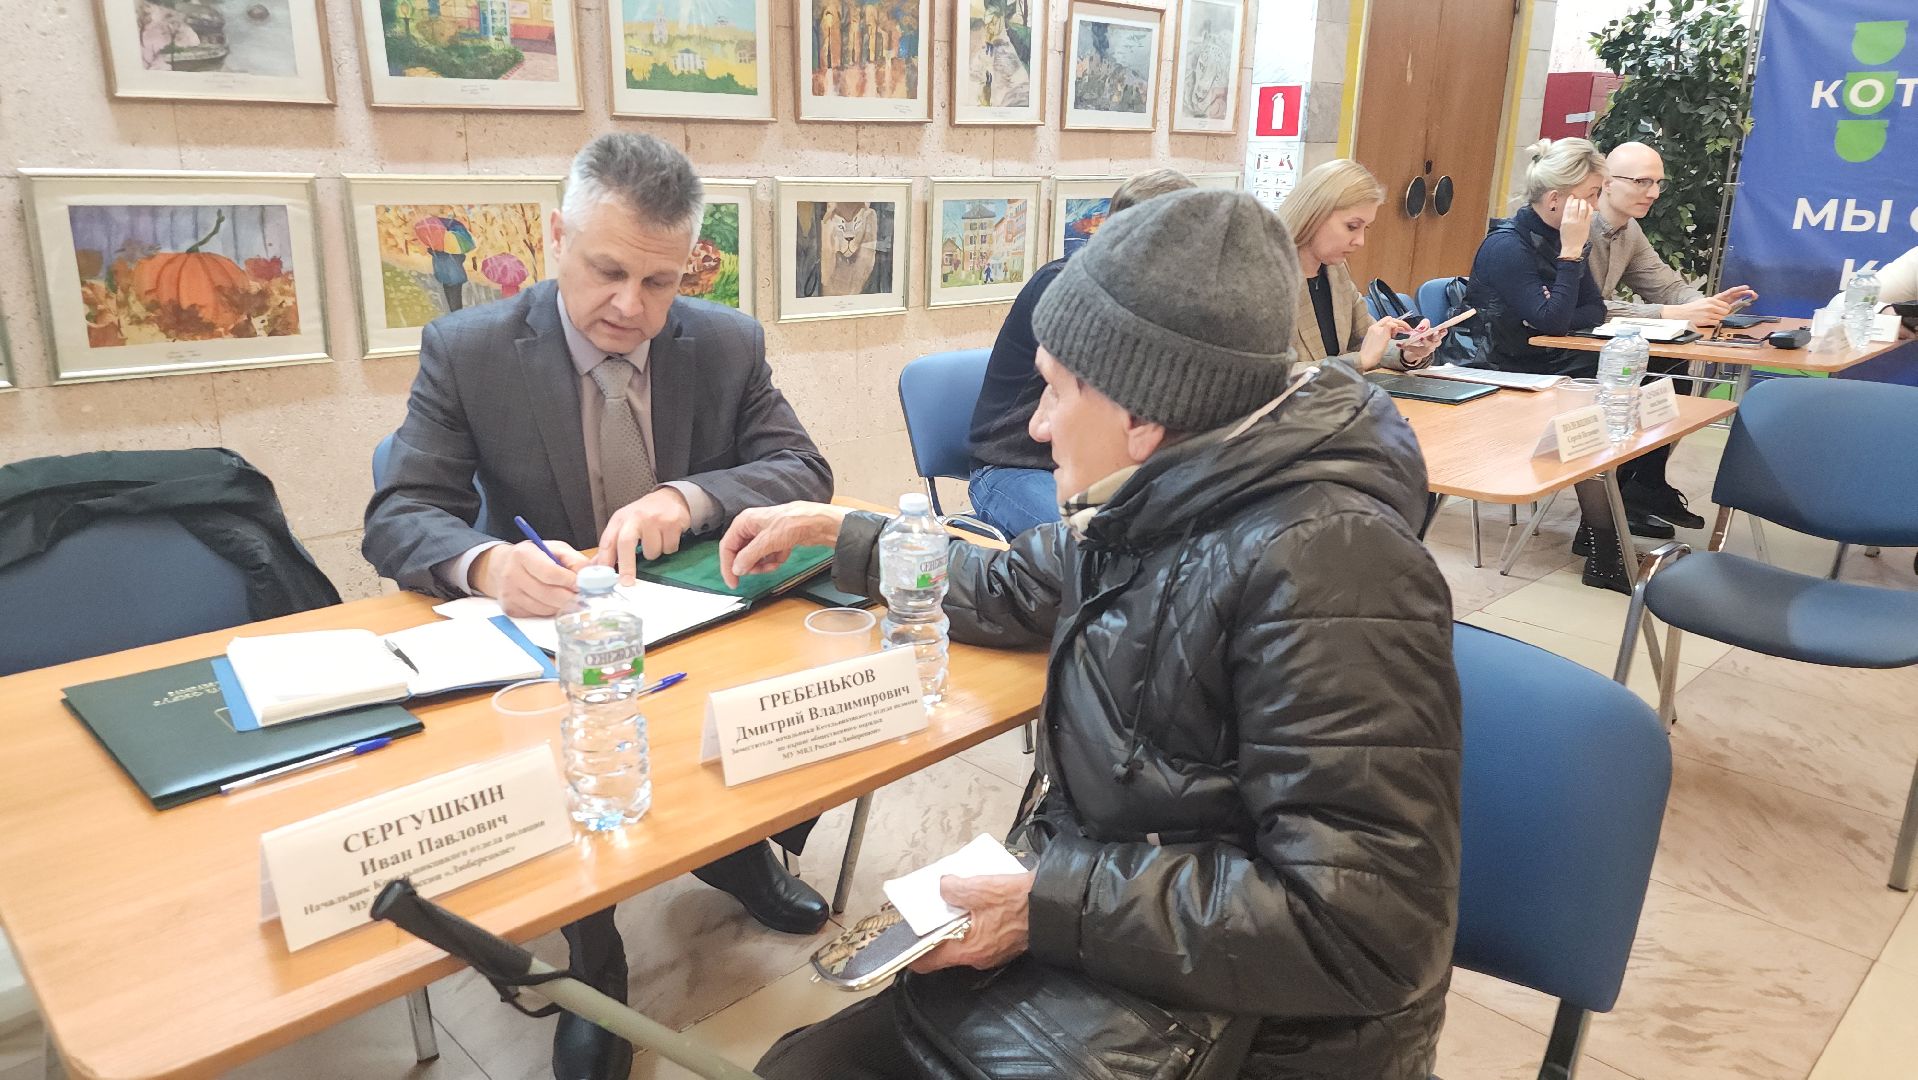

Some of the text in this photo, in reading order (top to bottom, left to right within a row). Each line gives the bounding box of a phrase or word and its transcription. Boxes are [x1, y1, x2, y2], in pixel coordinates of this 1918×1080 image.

[1792, 197, 1893, 233] МЫ
[736, 685, 911, 744] Дмитрий Владимирович
[758, 668, 876, 712] ГРЕБЕНЬКОВ
[343, 784, 506, 853] СЕРГУШКИН
[360, 814, 509, 877] Иван Павлович
[348, 900, 368, 914] МУ
